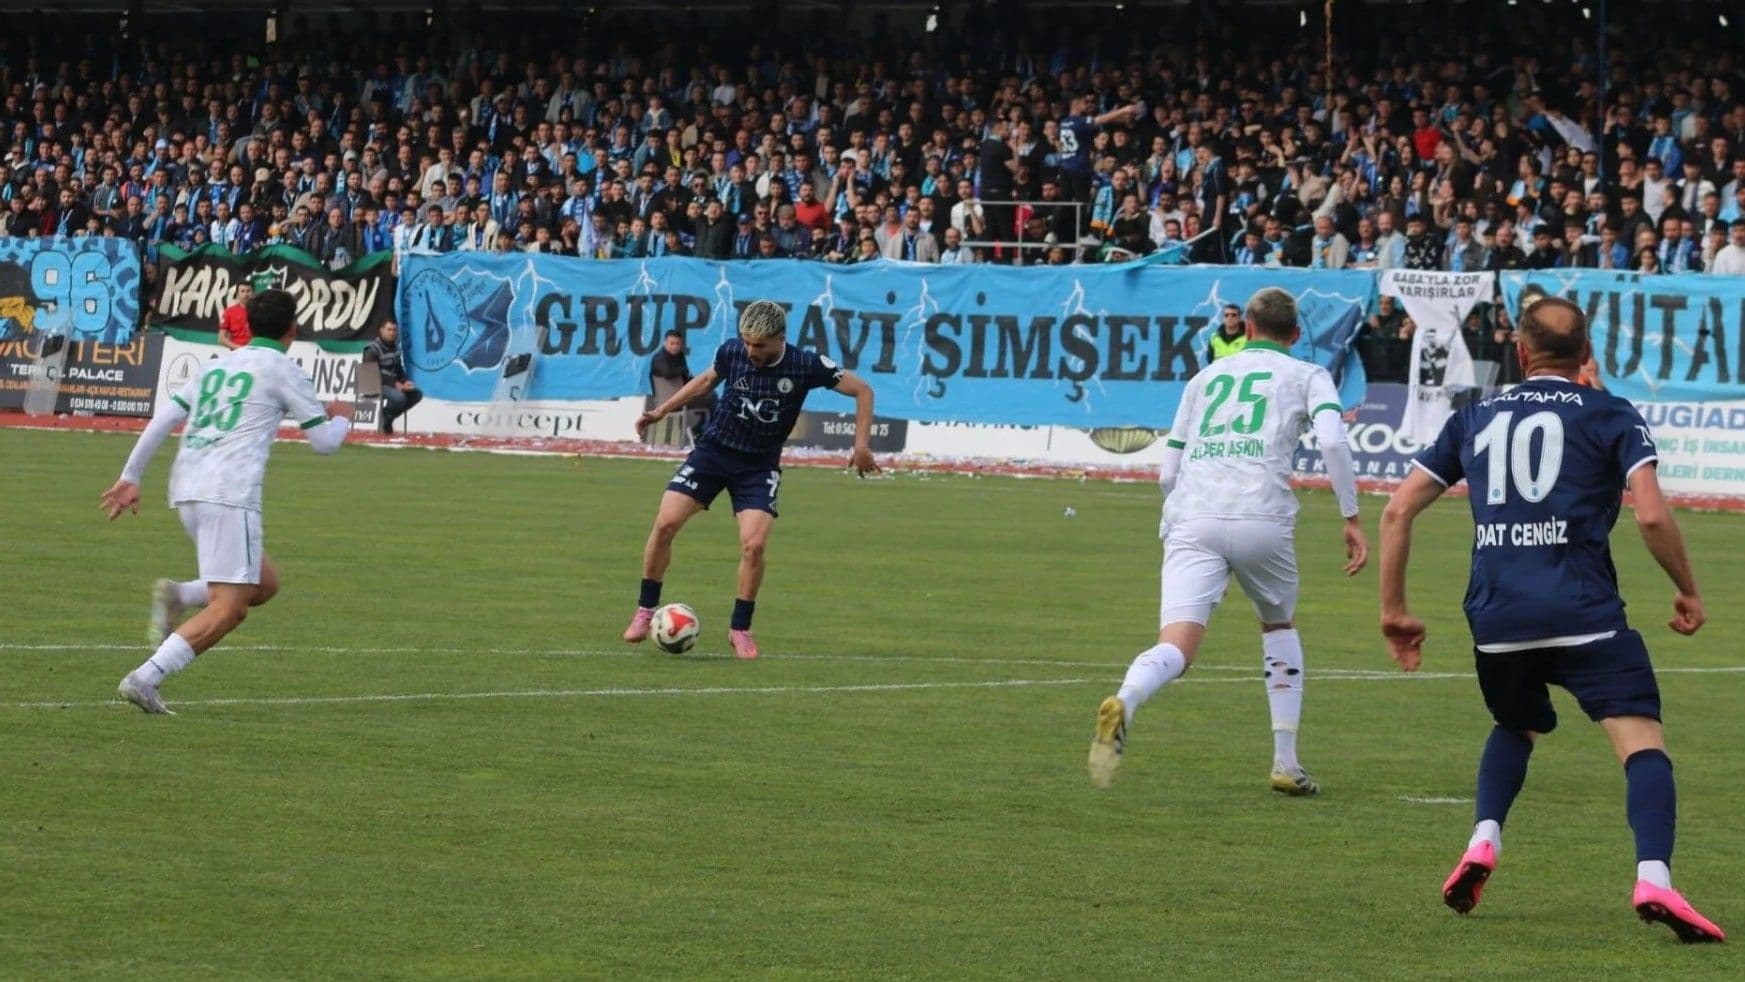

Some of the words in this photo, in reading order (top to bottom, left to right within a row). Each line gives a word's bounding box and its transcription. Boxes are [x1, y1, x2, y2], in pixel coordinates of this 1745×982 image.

[31, 250, 112, 333] 96
[159, 264, 238, 321] KAR
[68, 367, 124, 381] PALACE
[535, 292, 712, 358] GRUP
[921, 291, 1208, 402] ŞİMŞEK
[192, 367, 255, 431] 83
[1199, 372, 1273, 438] 25
[1474, 410, 1565, 505] 10
[1703, 436, 1745, 455] İNSA
[1511, 515, 1568, 547] CENGİZ
